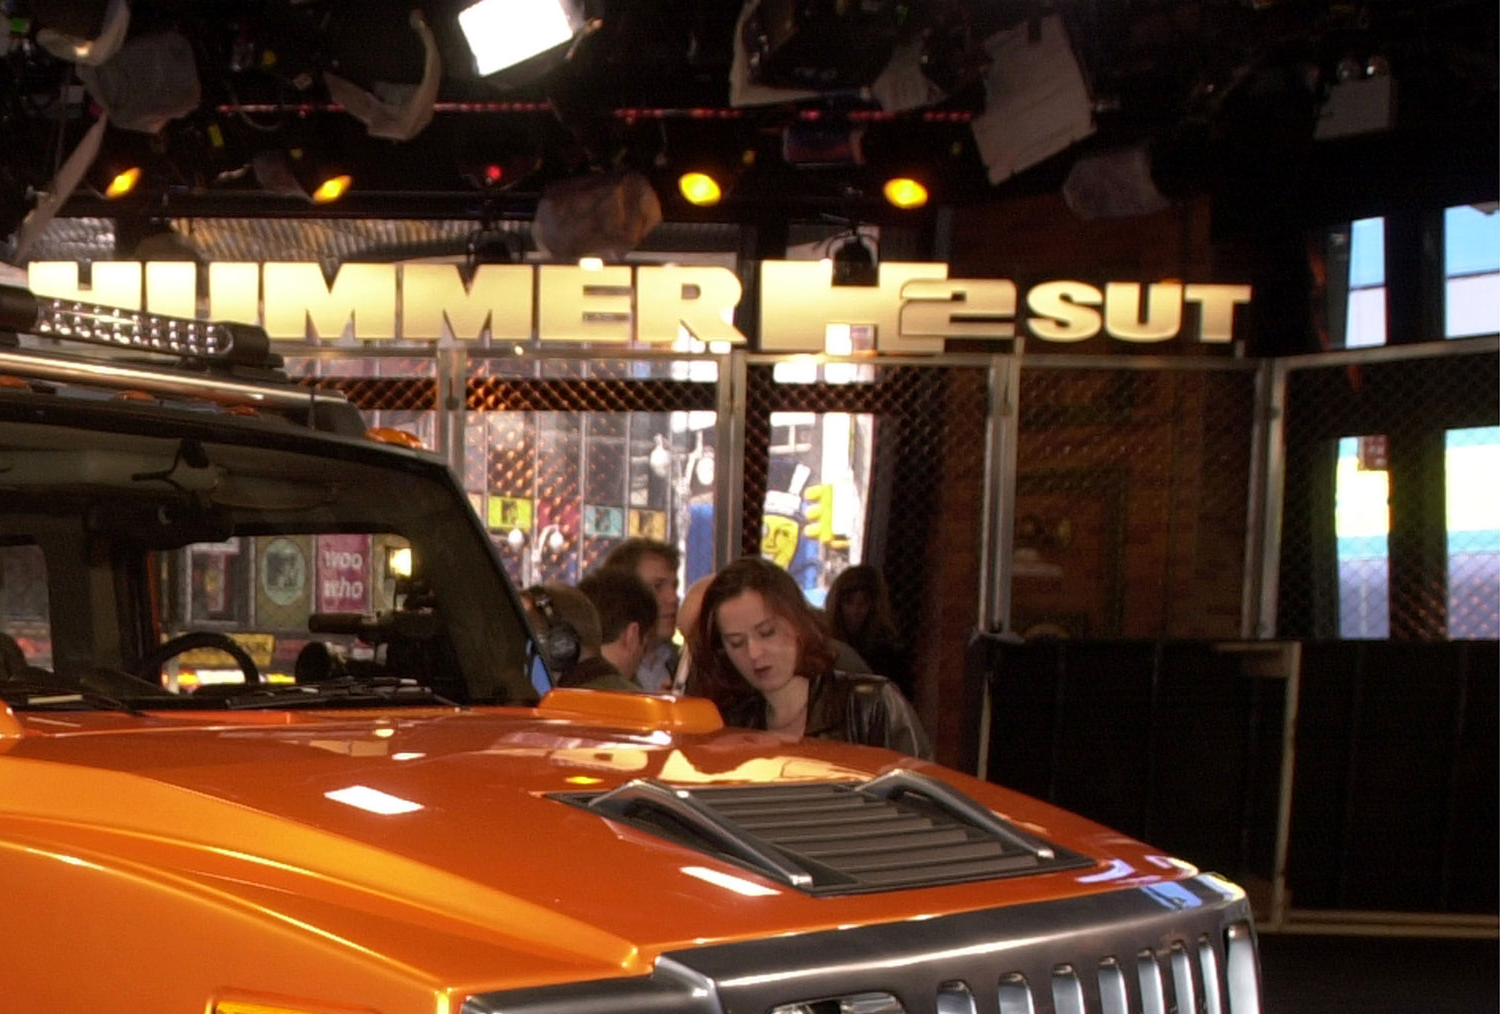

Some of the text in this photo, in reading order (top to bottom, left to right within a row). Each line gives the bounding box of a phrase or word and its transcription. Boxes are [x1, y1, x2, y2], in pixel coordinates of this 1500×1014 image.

[28, 260, 1252, 354] HUMMER H2 SUT
[322, 575, 364, 600] who
